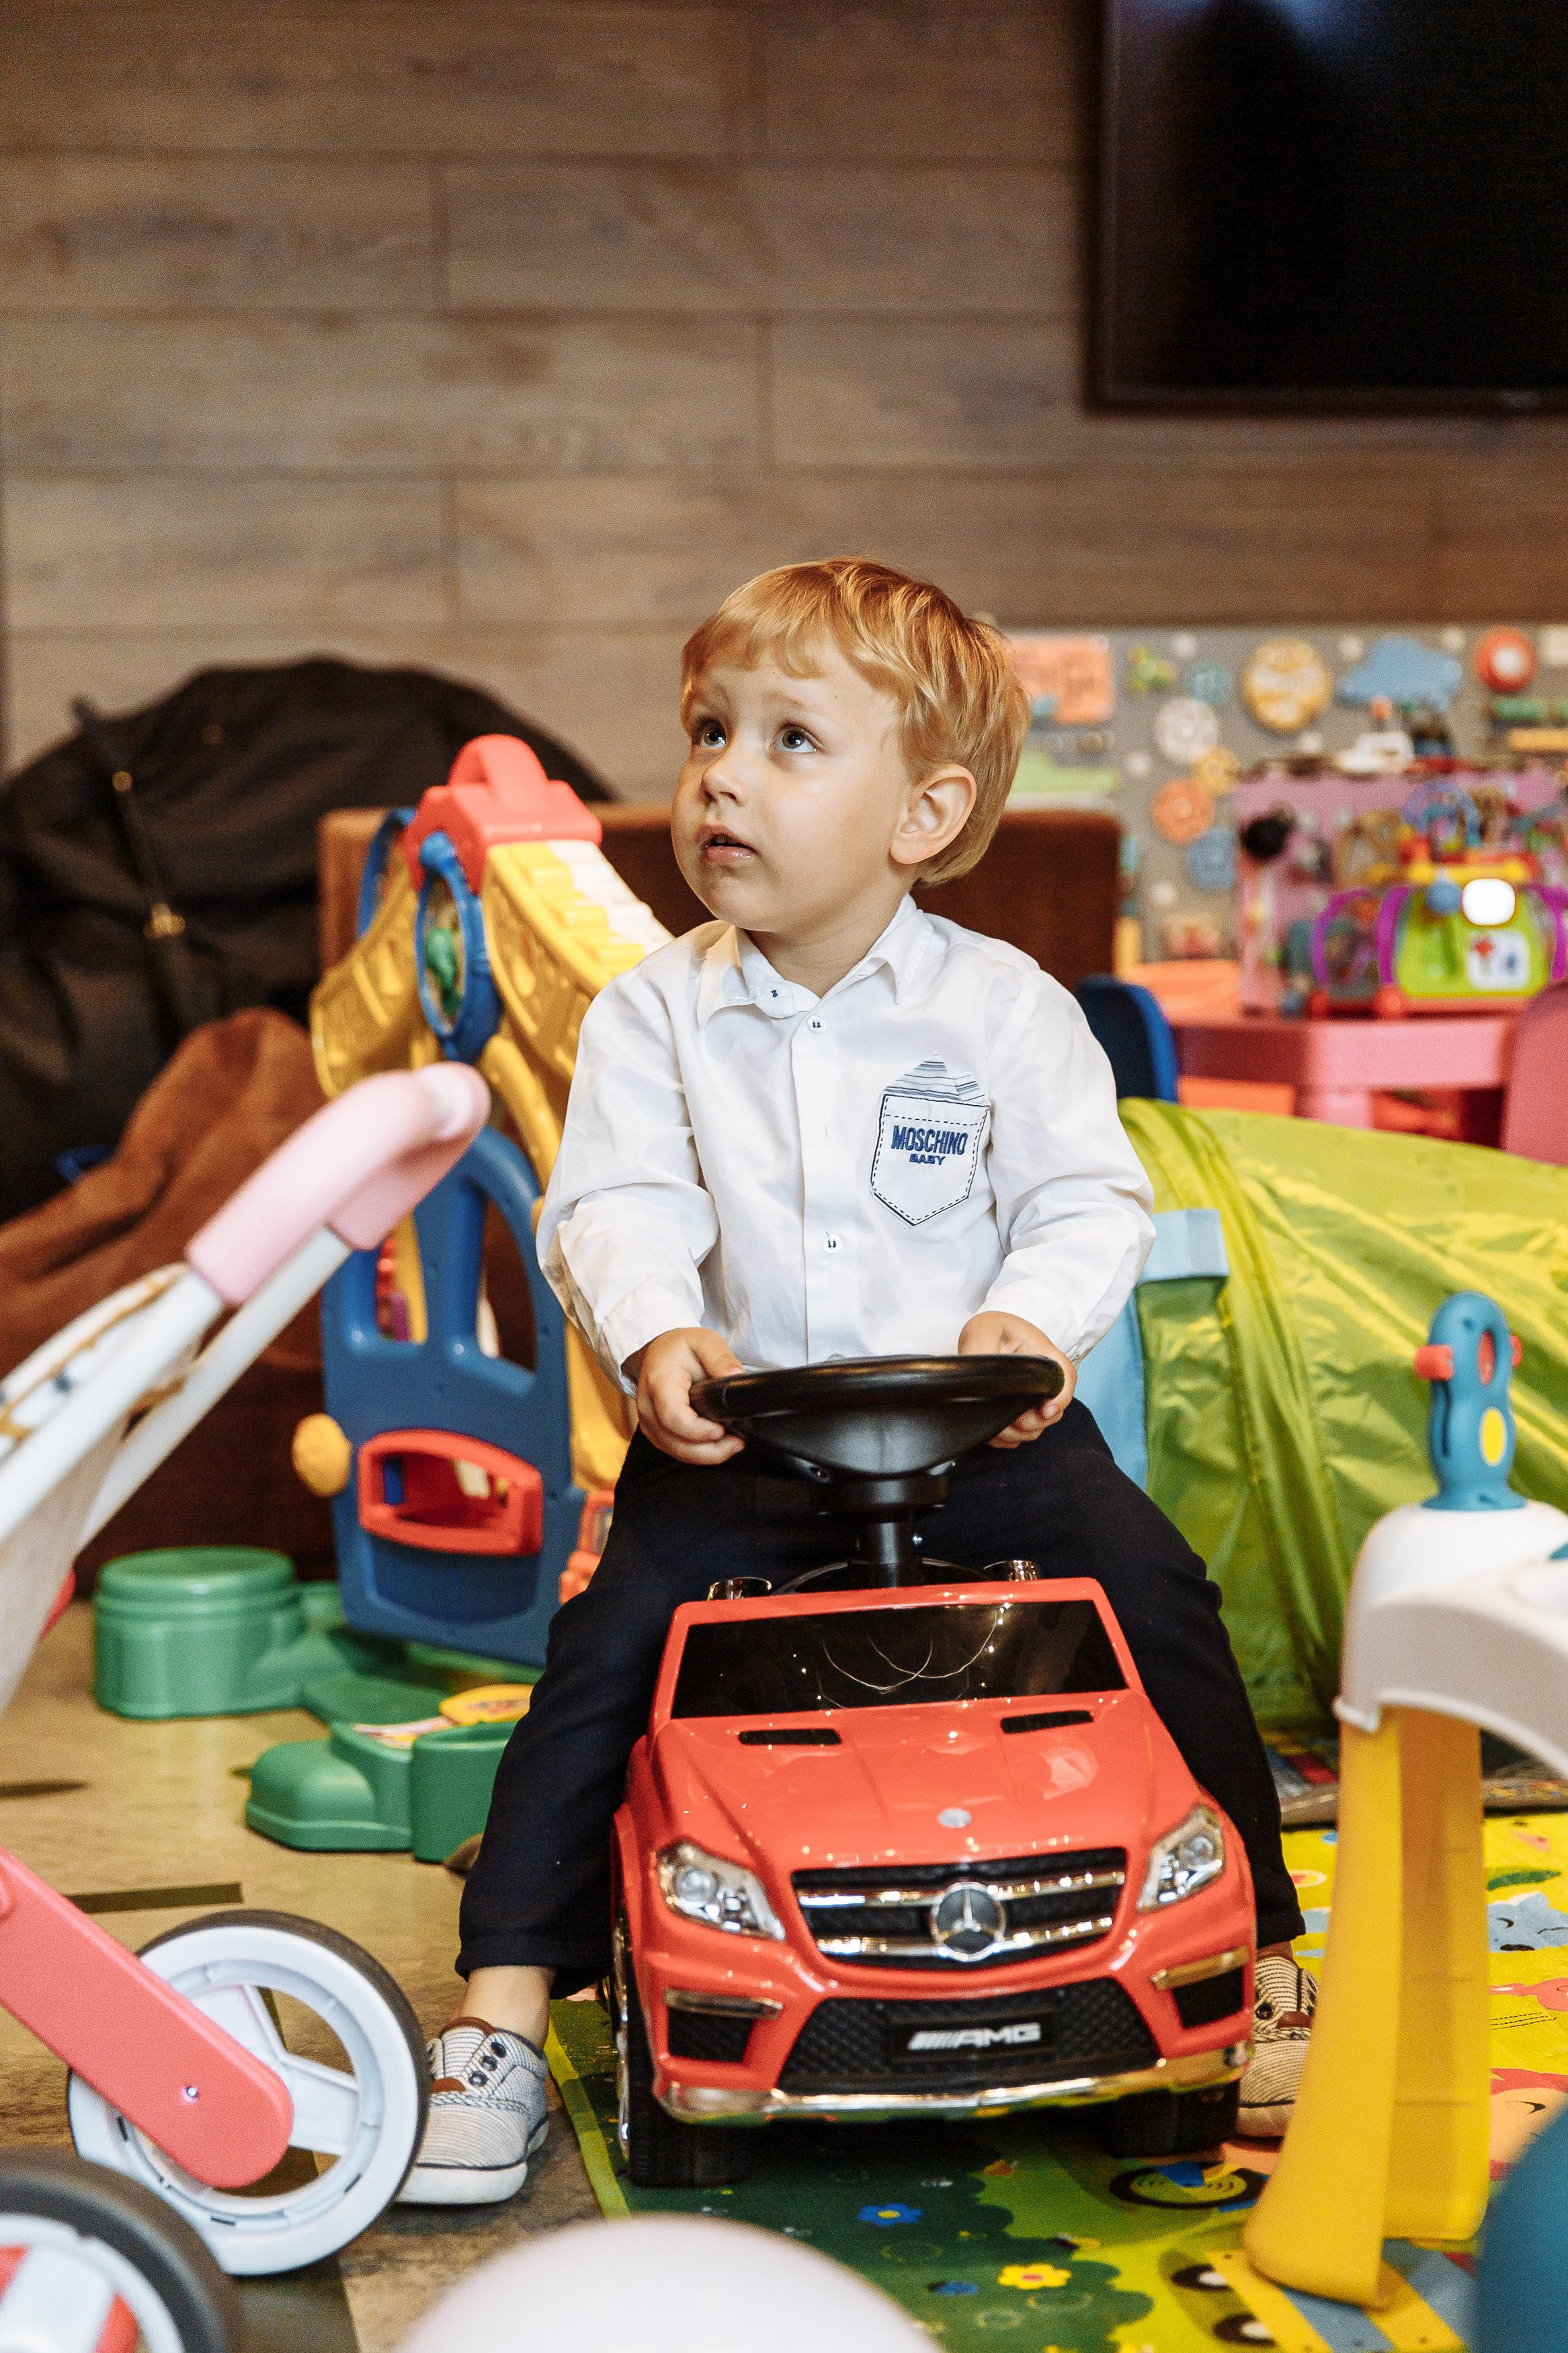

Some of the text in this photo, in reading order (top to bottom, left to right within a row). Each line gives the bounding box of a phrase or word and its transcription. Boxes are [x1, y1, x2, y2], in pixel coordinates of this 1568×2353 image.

[891, 1125, 968, 1155] MOSCHINO
[909, 1154, 946, 1165] BABY
[954, 2022, 1041, 2048] AMG
